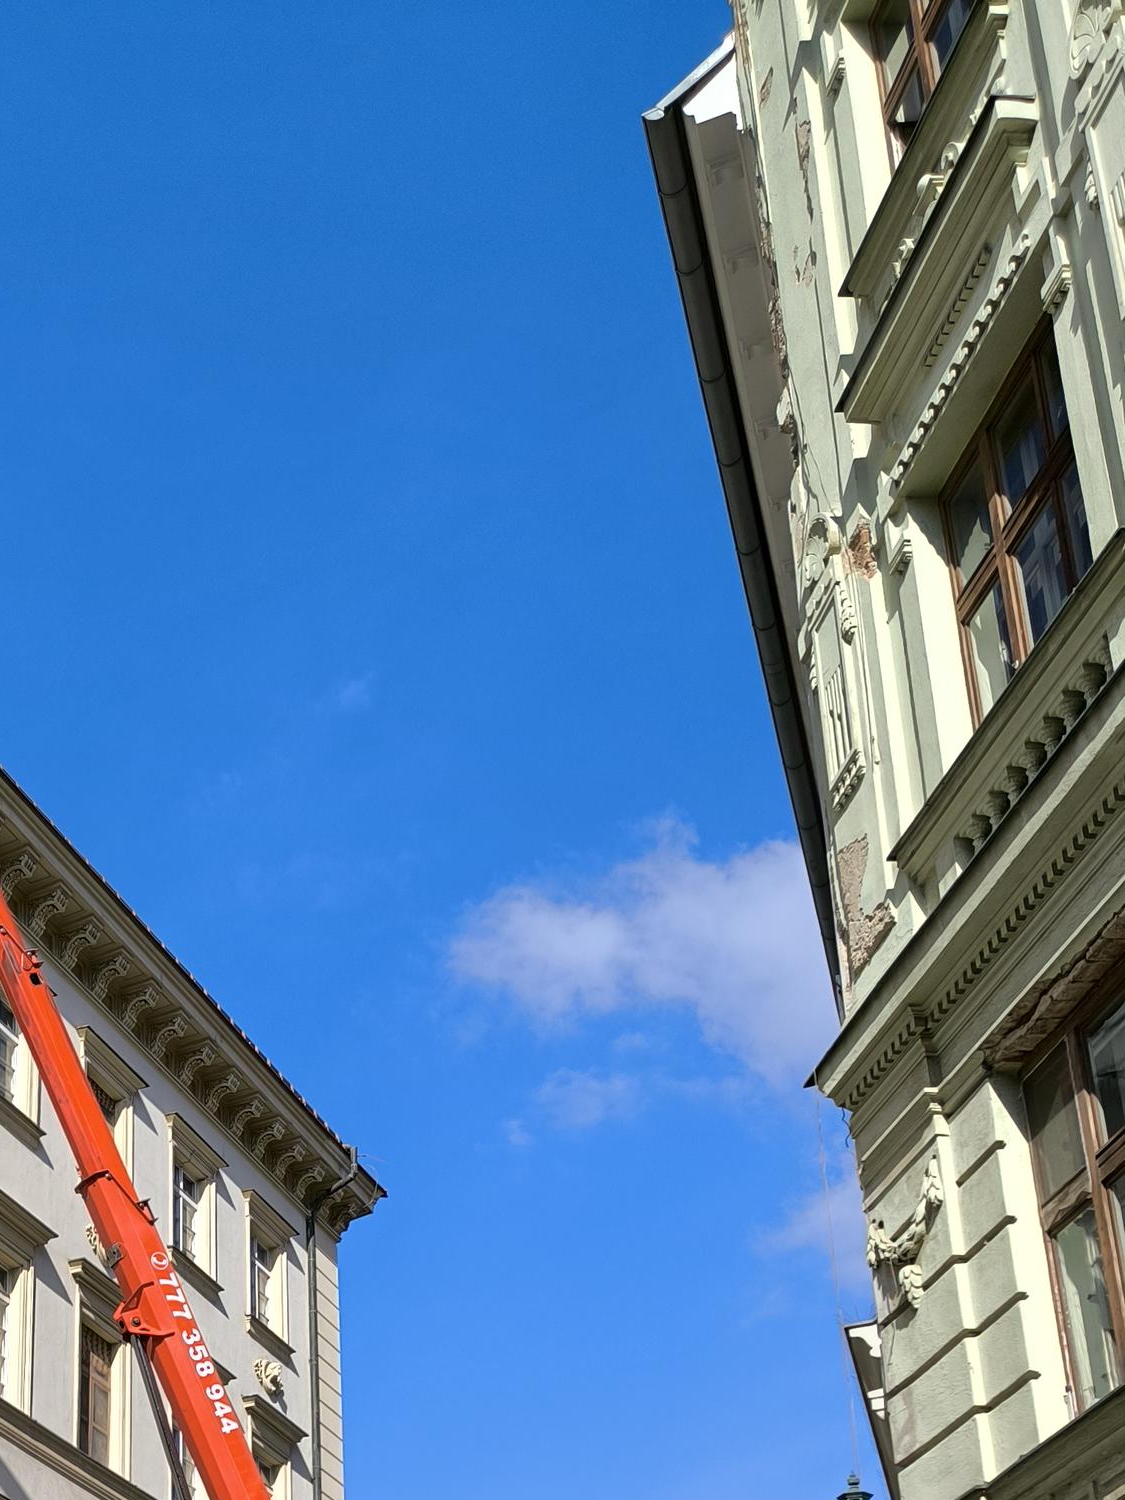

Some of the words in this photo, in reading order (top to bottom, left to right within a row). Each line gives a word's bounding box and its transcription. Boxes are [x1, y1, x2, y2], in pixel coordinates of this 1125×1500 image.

[158, 1272, 193, 1320] 777
[181, 1328, 215, 1378] 358
[205, 1383, 240, 1435] 944
